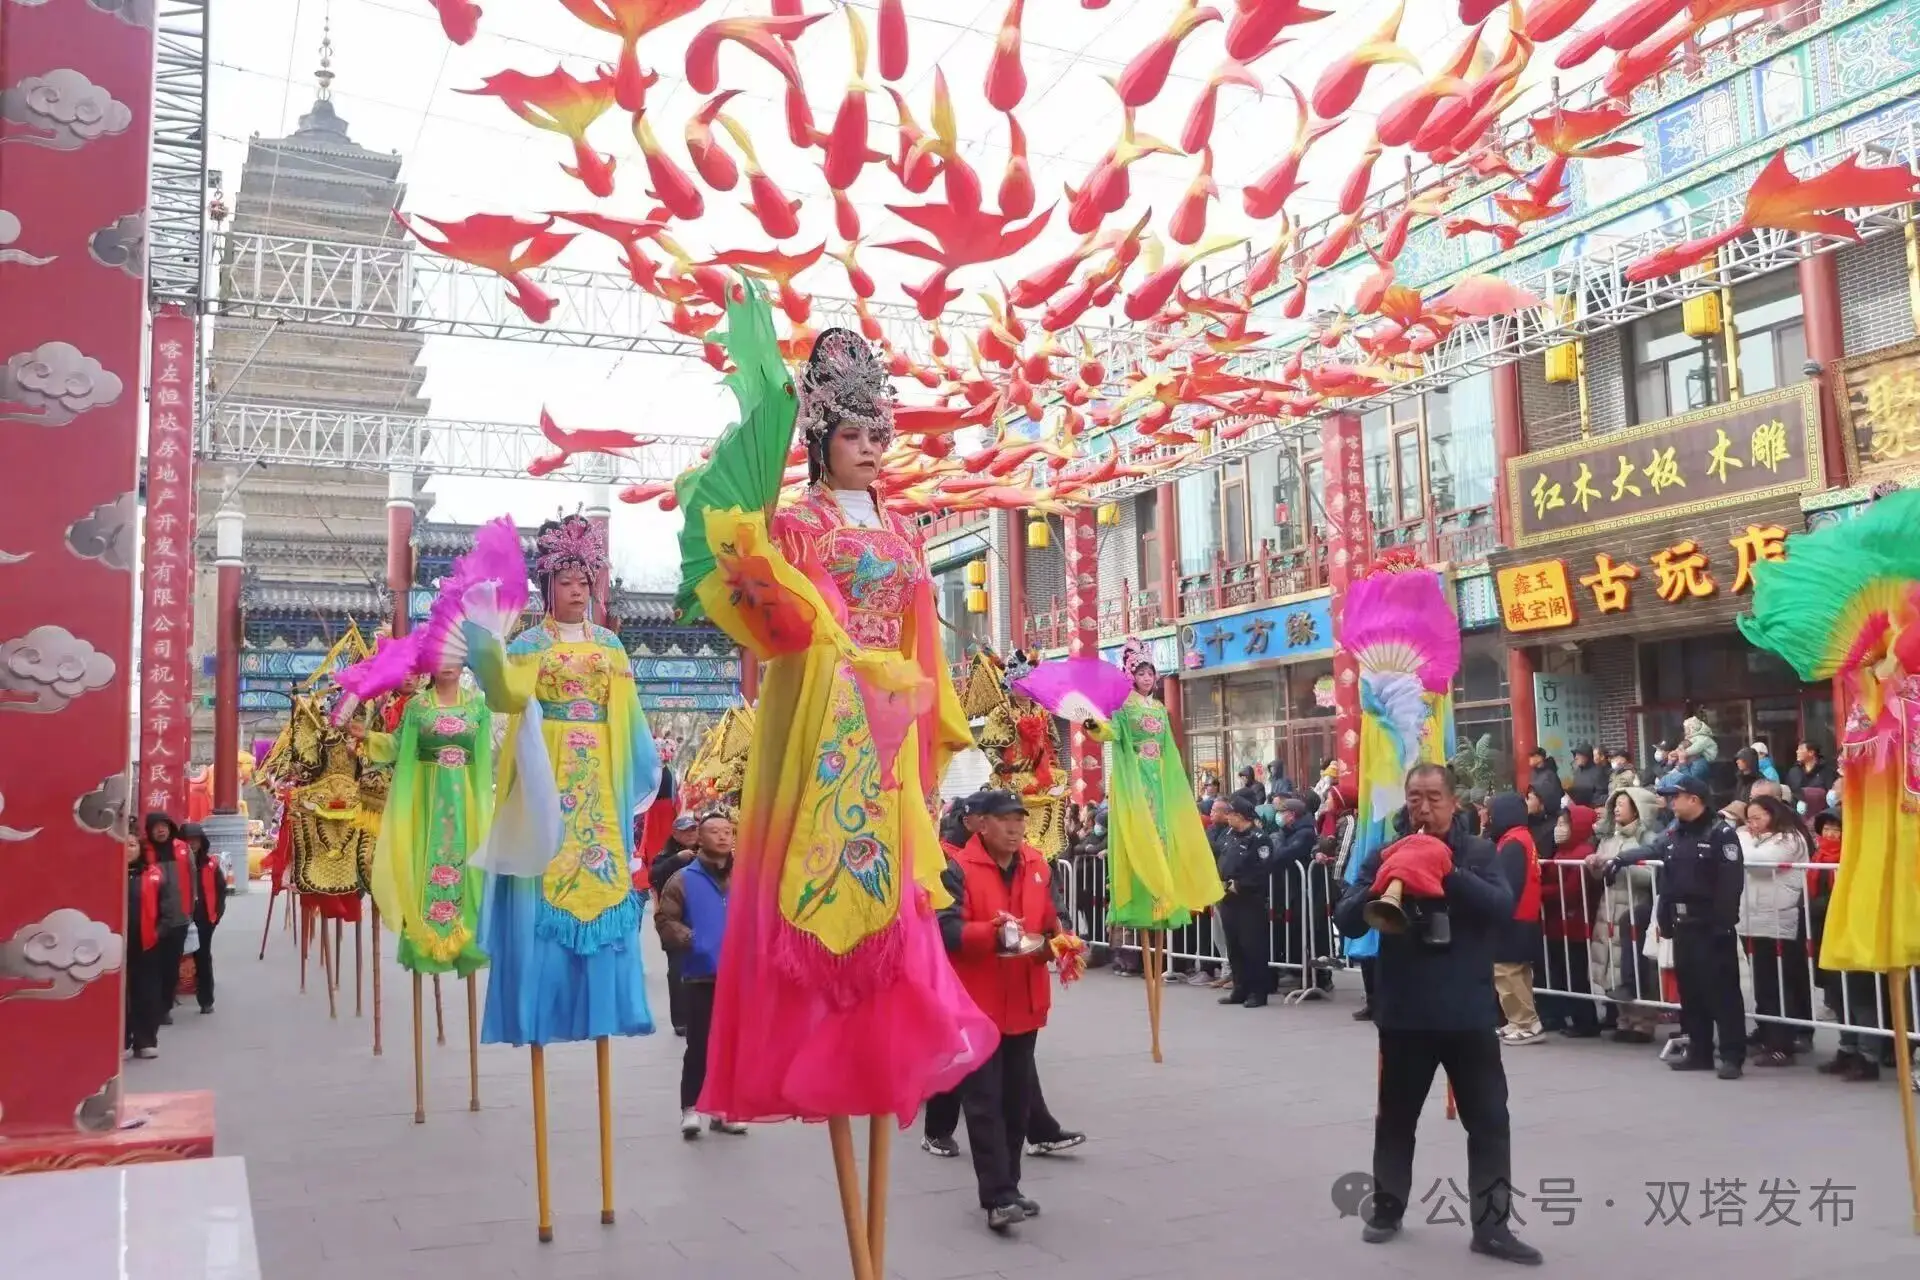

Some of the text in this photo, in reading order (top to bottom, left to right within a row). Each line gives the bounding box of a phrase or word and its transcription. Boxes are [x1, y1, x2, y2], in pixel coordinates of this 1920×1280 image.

[1531, 419, 1791, 520] 红木大板 木雕
[1509, 596, 1567, 624] 藏宝阁
